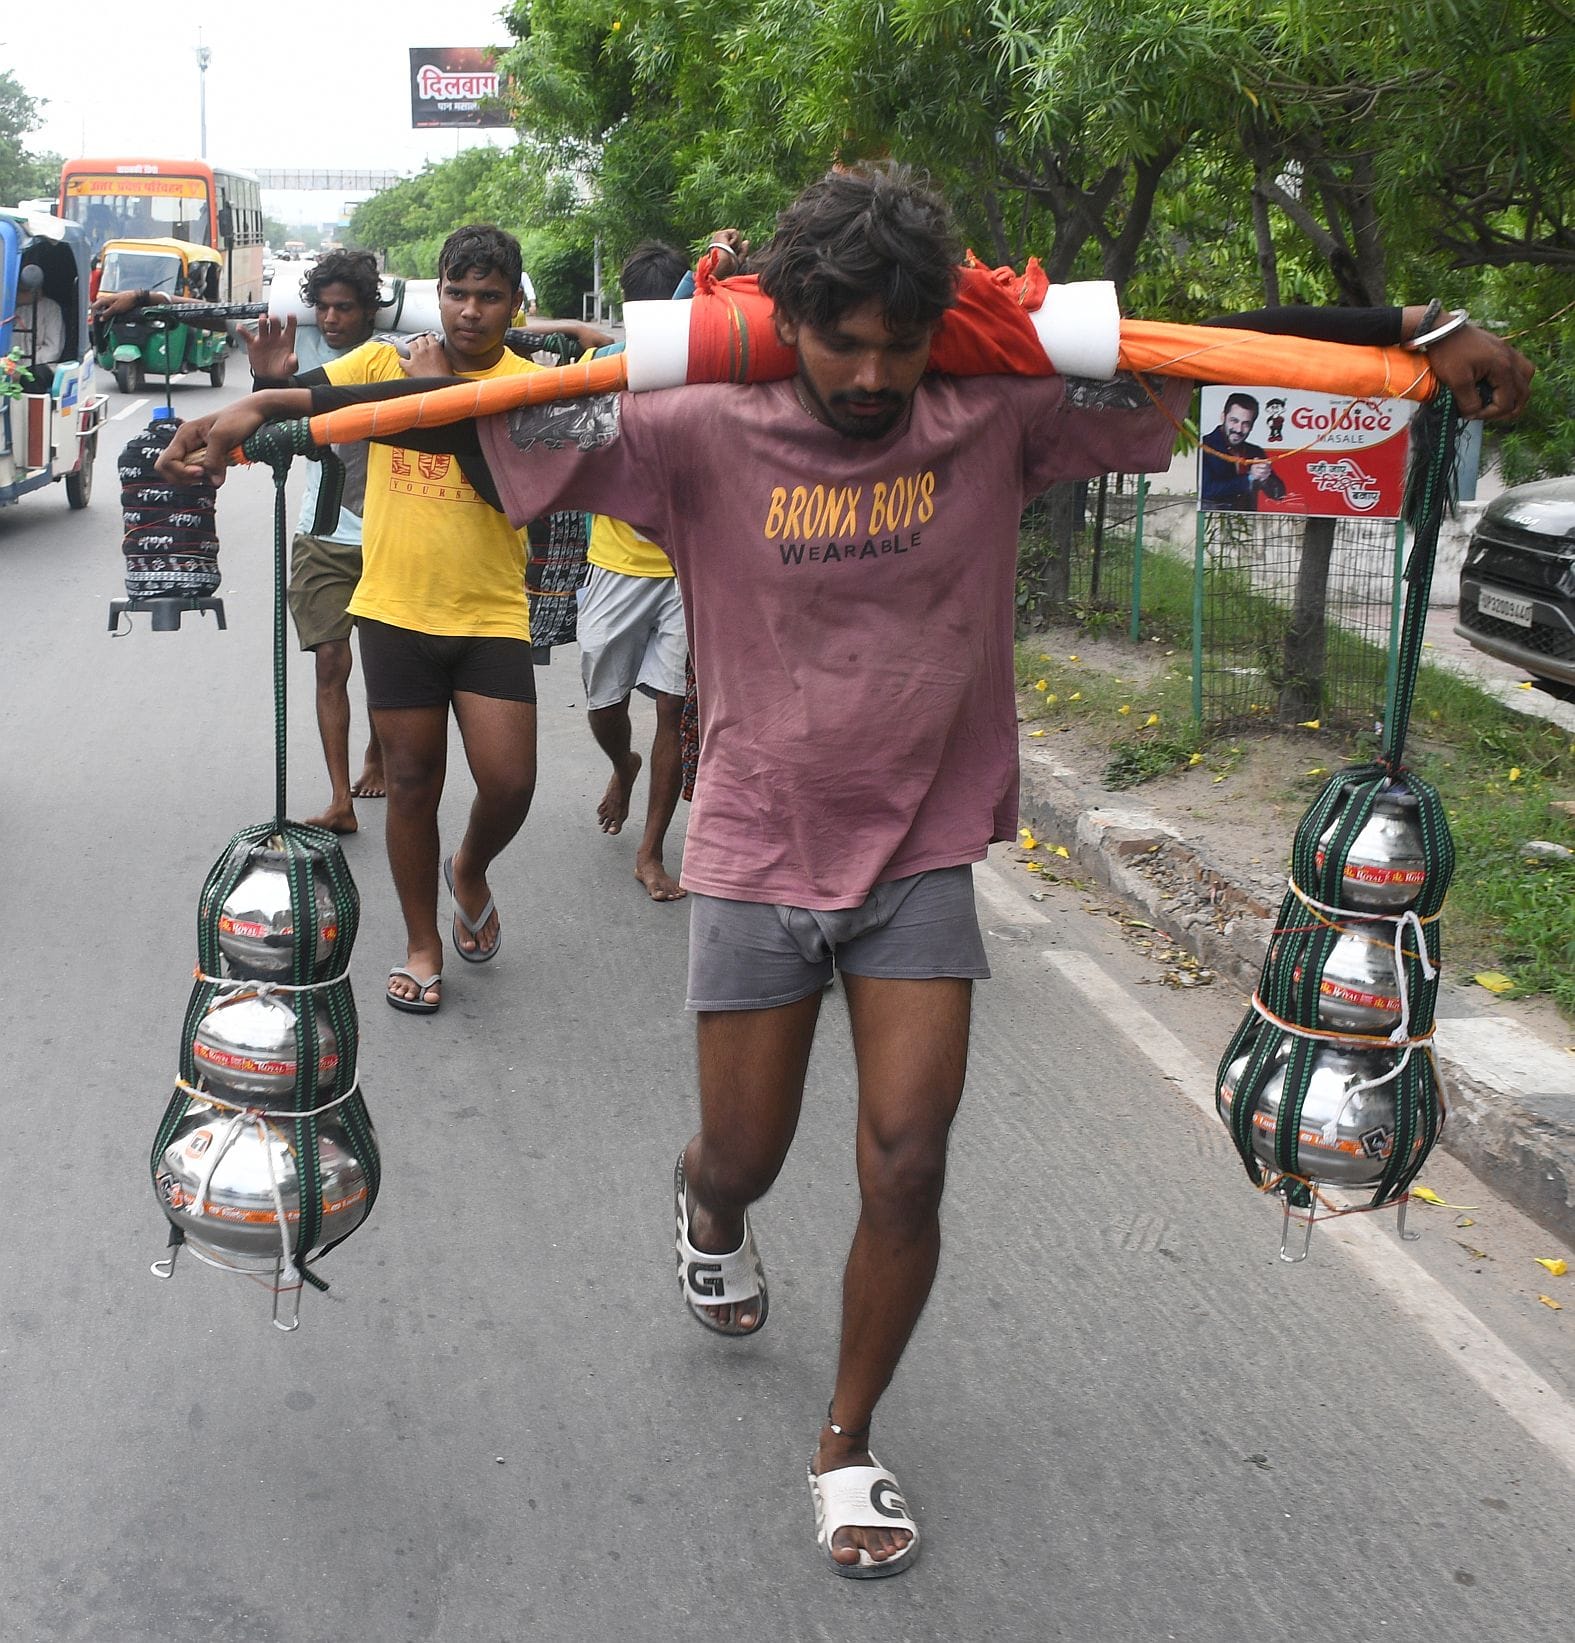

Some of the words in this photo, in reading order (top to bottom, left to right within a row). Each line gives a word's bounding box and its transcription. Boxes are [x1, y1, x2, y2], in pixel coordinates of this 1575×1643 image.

[420, 67, 497, 97] दिलबाग
[764, 484, 862, 540] BRONX
[868, 470, 935, 536] BOYS
